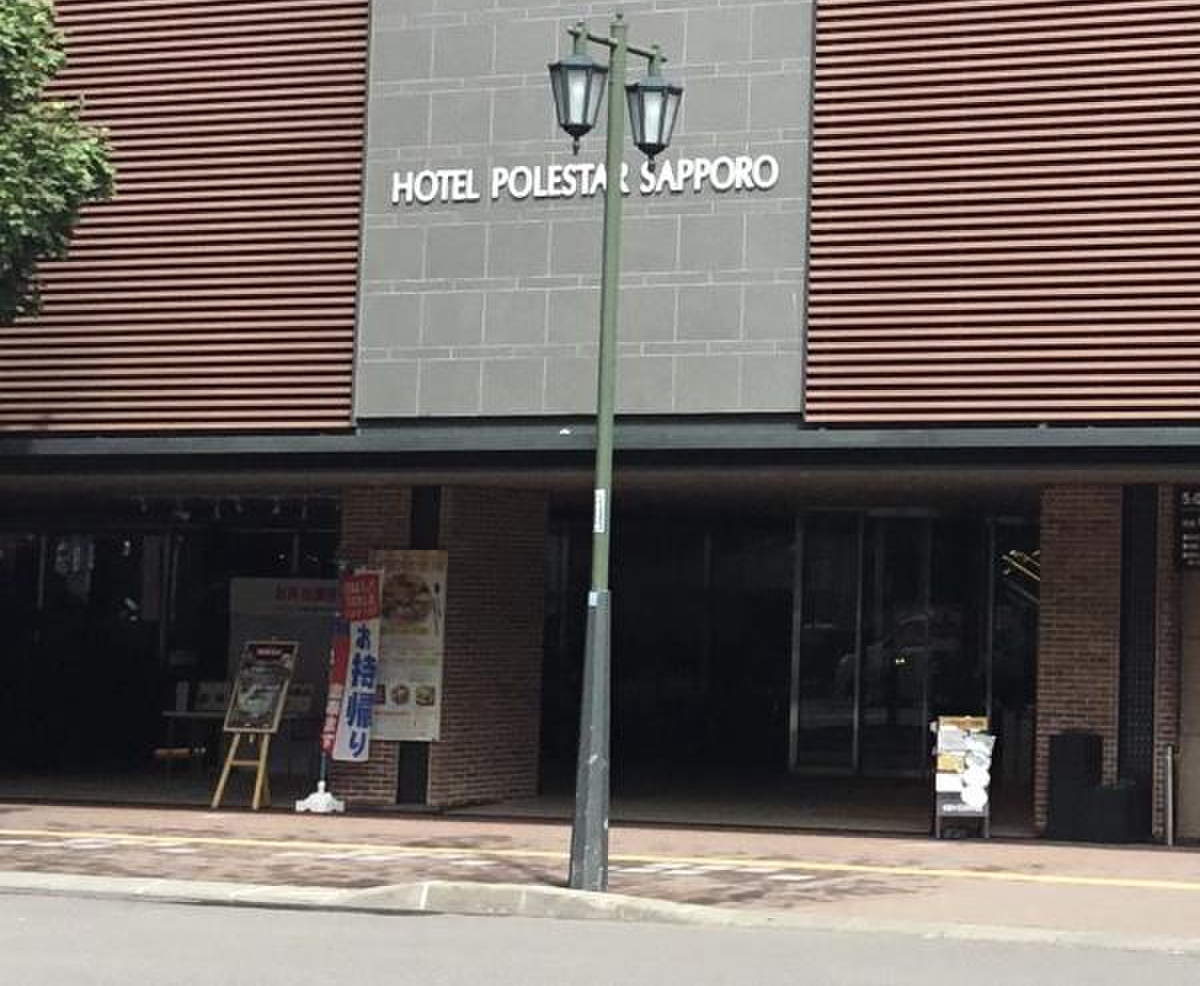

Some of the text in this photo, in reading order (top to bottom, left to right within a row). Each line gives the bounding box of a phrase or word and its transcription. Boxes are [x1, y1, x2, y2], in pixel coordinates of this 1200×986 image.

[391, 168, 480, 204] HOTEL
[639, 154, 780, 195] SAPPORO
[346, 623, 377, 758] お持帰り
